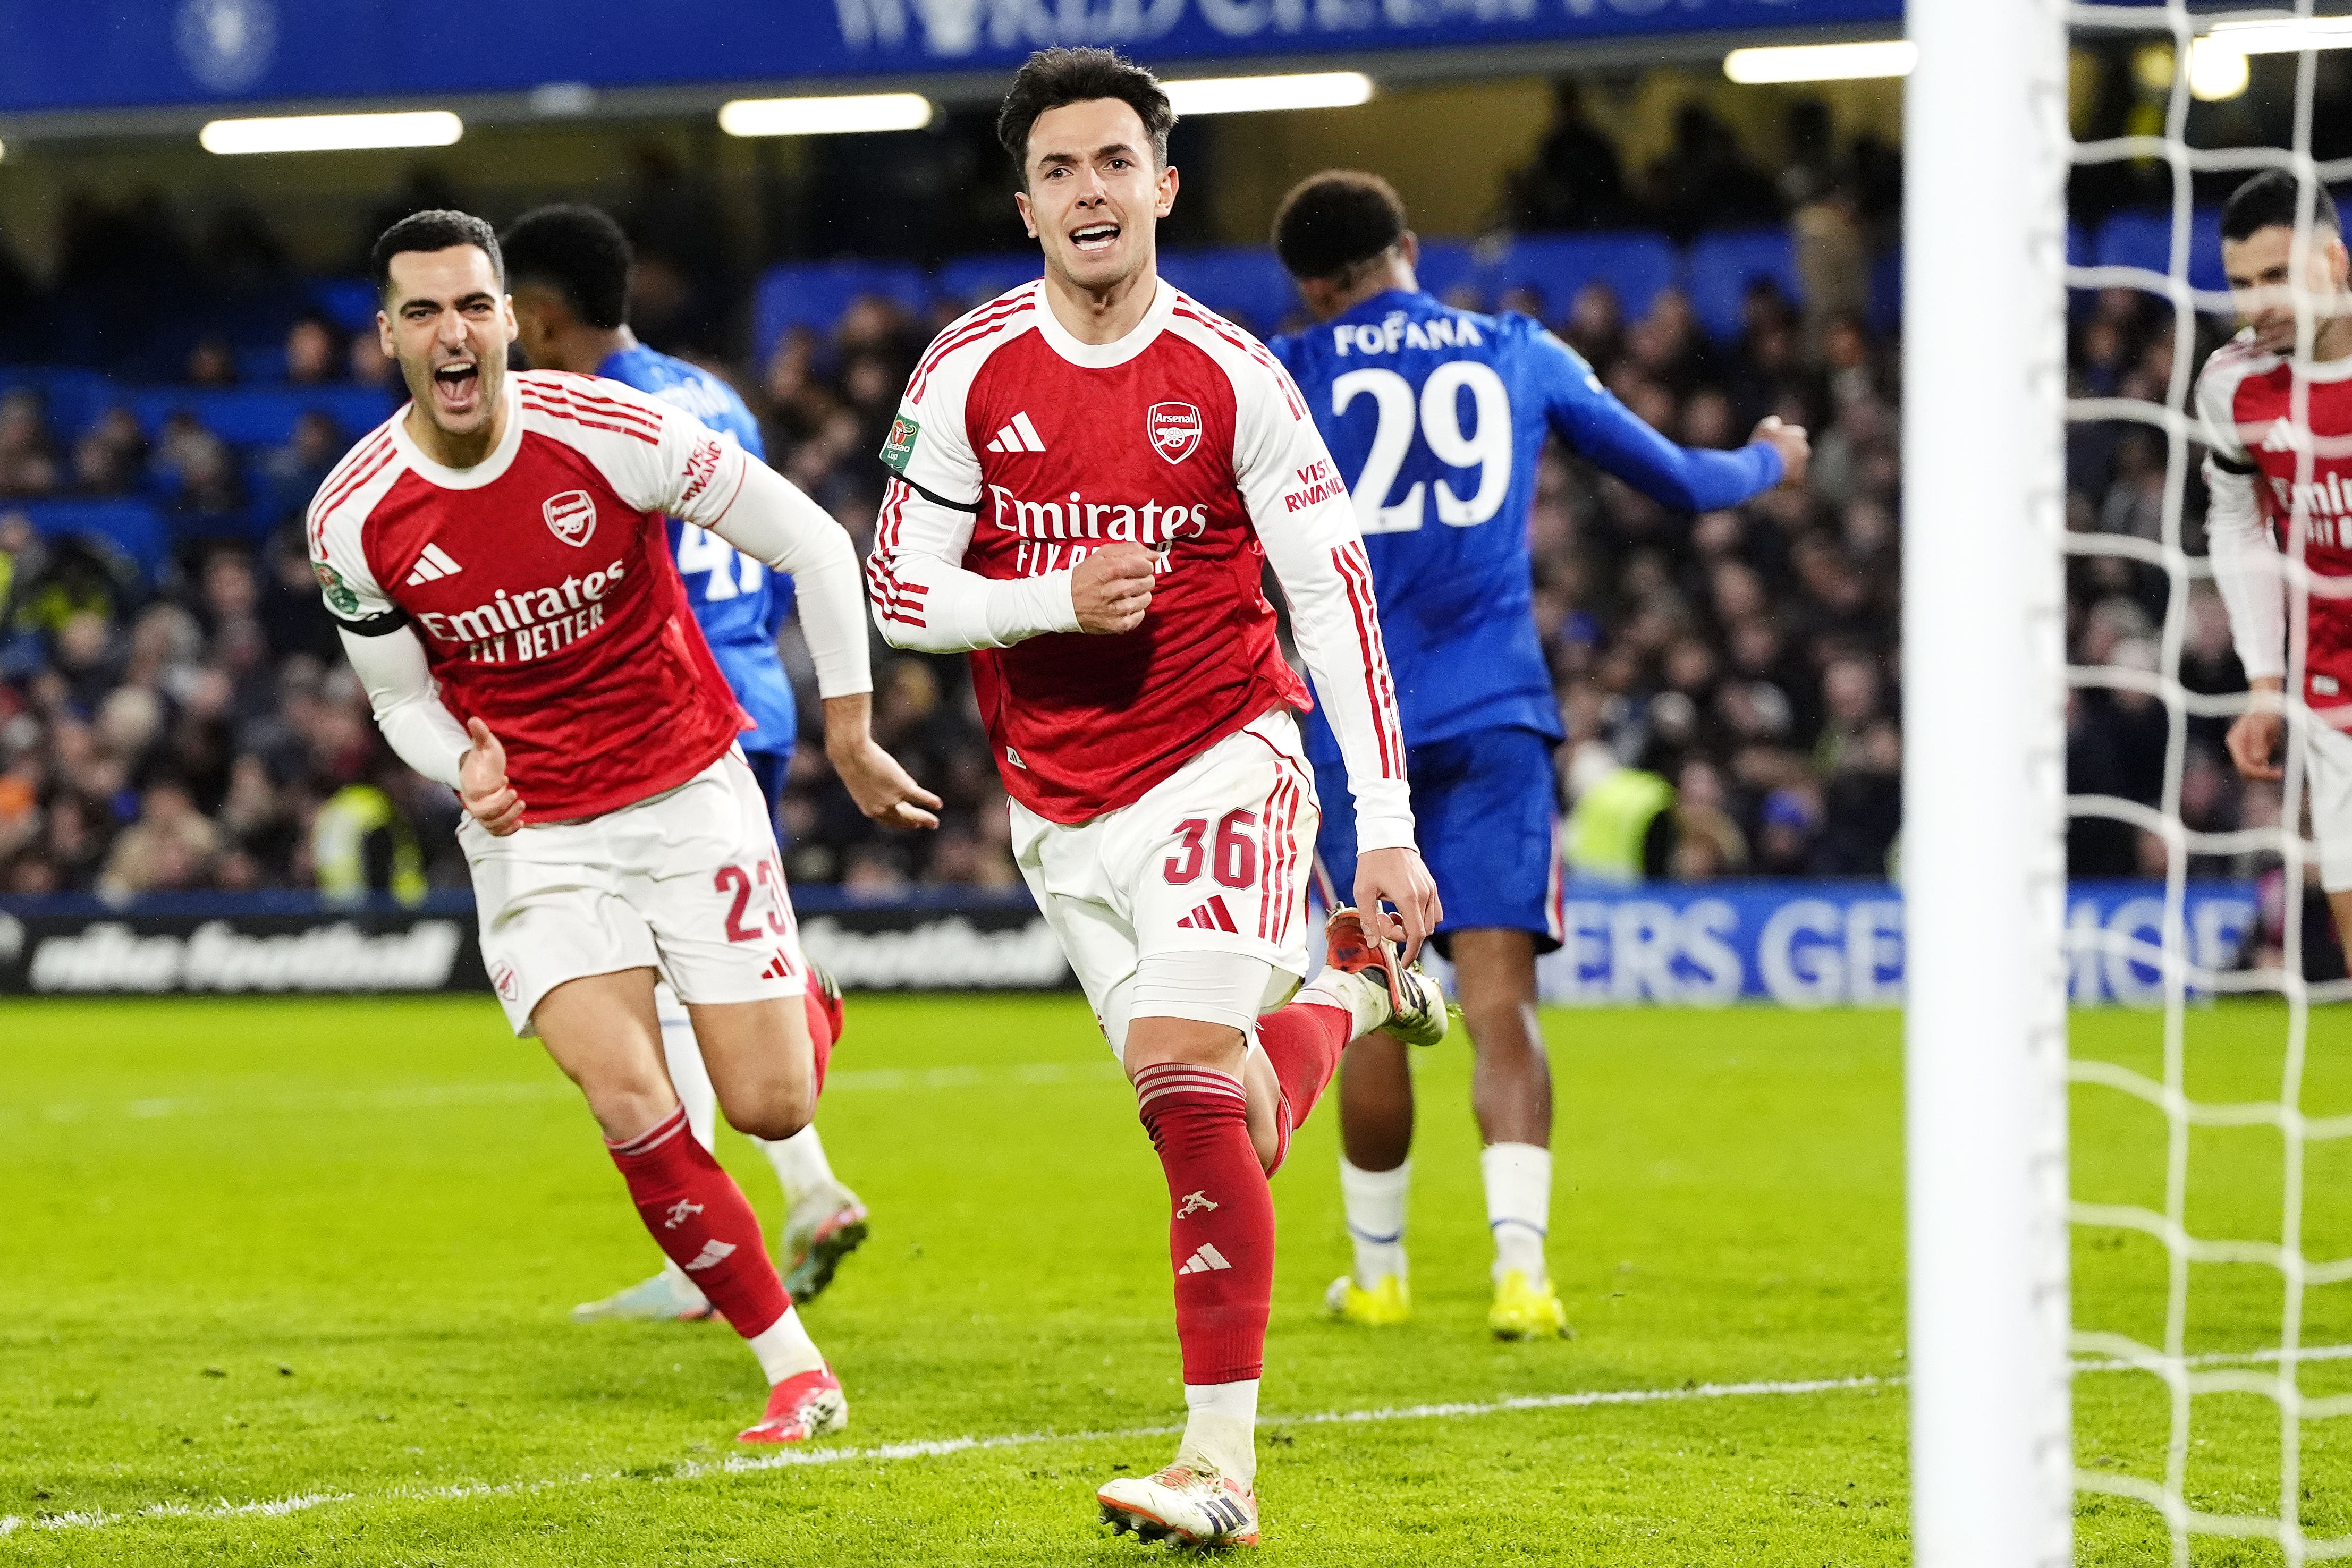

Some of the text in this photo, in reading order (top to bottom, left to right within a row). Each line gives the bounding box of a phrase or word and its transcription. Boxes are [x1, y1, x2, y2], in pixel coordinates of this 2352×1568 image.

[1333, 310, 1483, 357] FOFANA
[1155, 413, 1194, 423] Arsenal
[1332, 360, 1513, 536] 29
[988, 484, 1208, 544] Emirates
[1016, 539, 1062, 578] FLY
[417, 558, 625, 642] Emirates
[515, 602, 605, 662] BETTER
[1162, 807, 1258, 891] 36
[714, 860, 786, 943] 23
